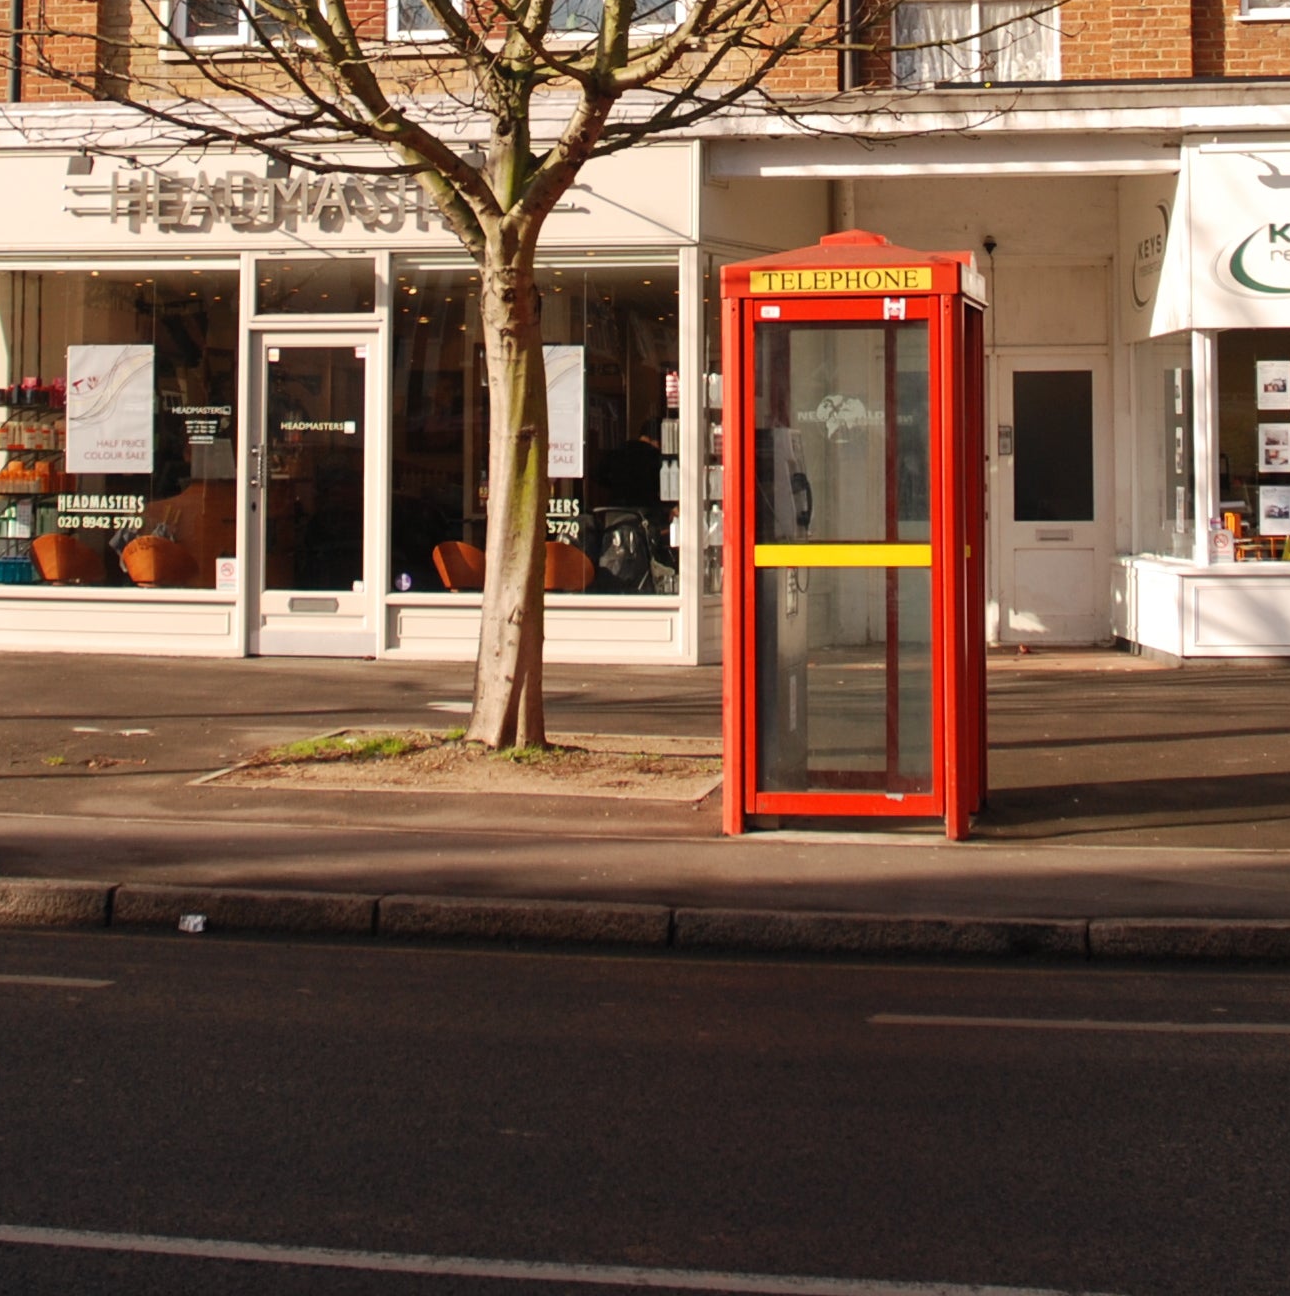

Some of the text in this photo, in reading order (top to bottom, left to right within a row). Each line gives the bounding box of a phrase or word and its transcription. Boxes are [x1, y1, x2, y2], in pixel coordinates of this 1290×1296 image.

[110, 170, 447, 224] HEADMAST
[1138, 234, 1162, 260] KEYS
[762, 269, 919, 291] TELEPHONE
[280, 421, 344, 431] HEADMASTERS
[96, 439, 146, 448] HALF PRICE
[84, 451, 147, 460] COLOUR SALE
[553, 455, 575, 464] SALE
[57, 494, 144, 513] HEADMASTERS
[57, 515, 143, 529] 020 8942 5770
